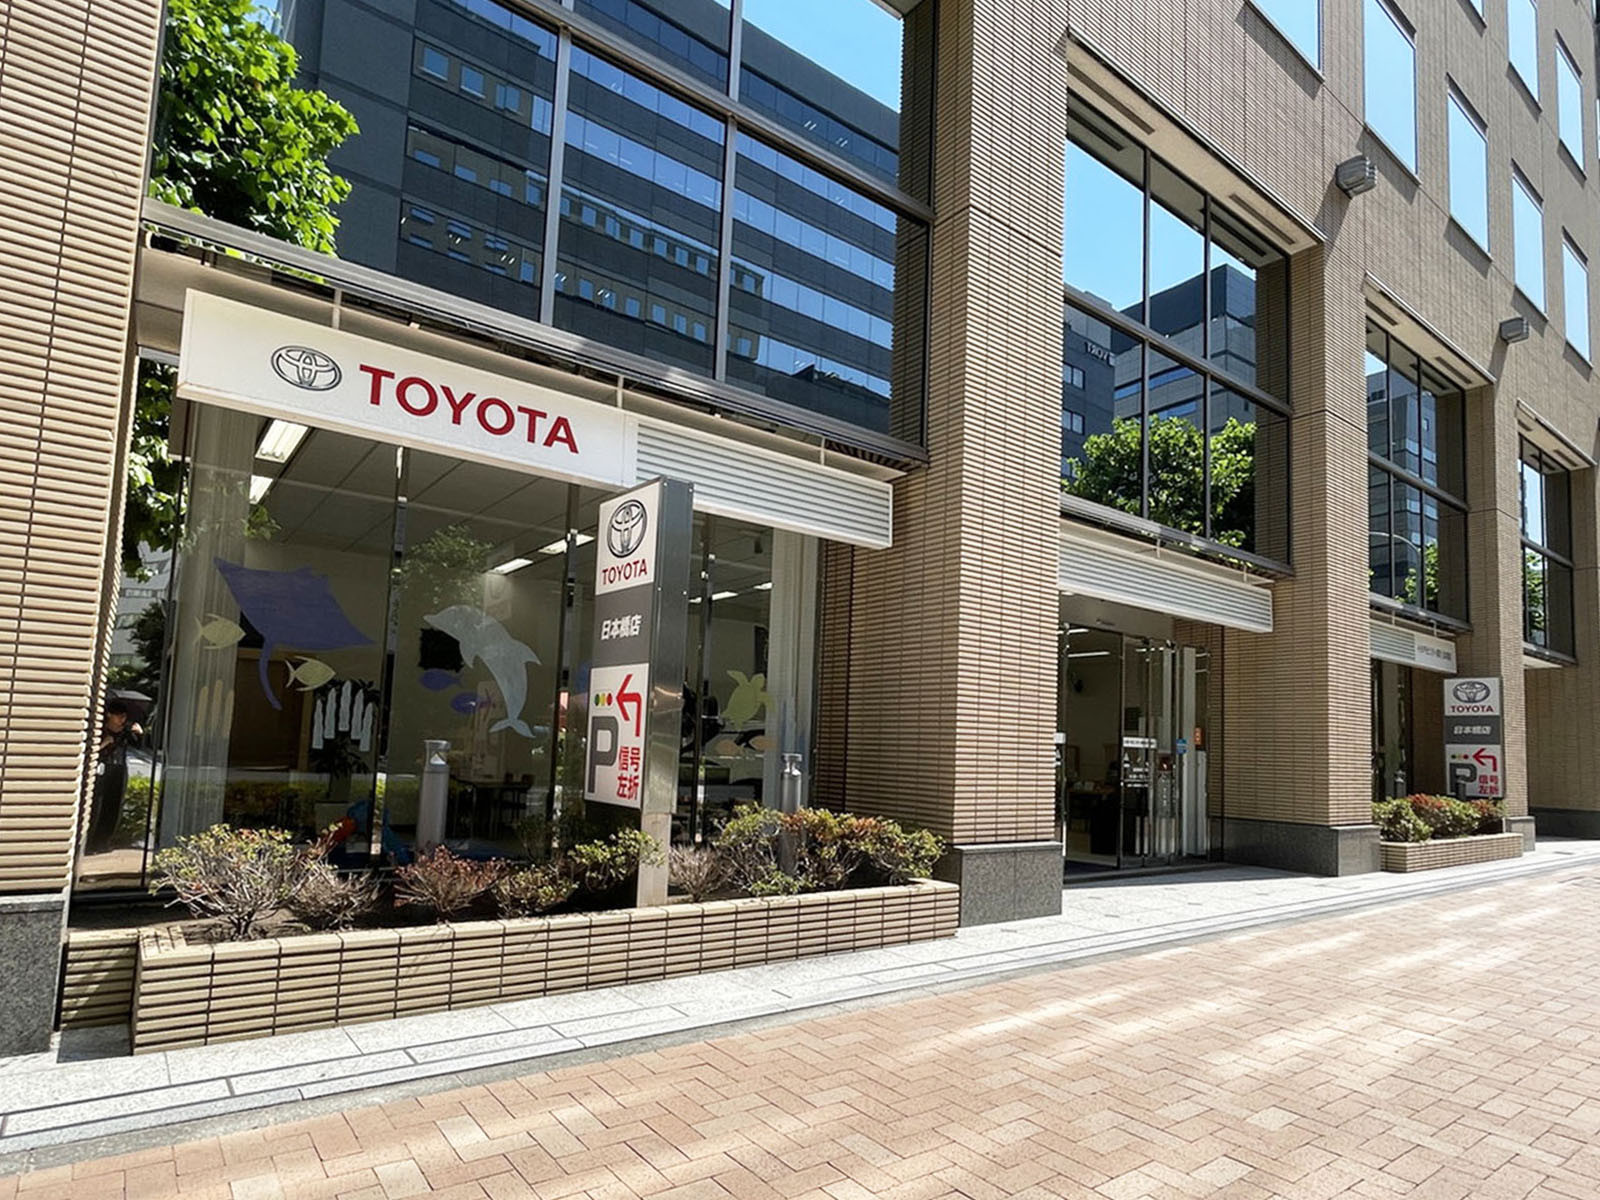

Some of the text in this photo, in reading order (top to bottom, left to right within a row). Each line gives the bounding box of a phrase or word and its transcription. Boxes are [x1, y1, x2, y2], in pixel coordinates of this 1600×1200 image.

[359, 364, 579, 454] TOYOTA
[602, 559, 647, 585] TOYOTA
[601, 614, 642, 640] 日本橋店
[1451, 705, 1494, 713] TOYOTA
[587, 716, 619, 793] P
